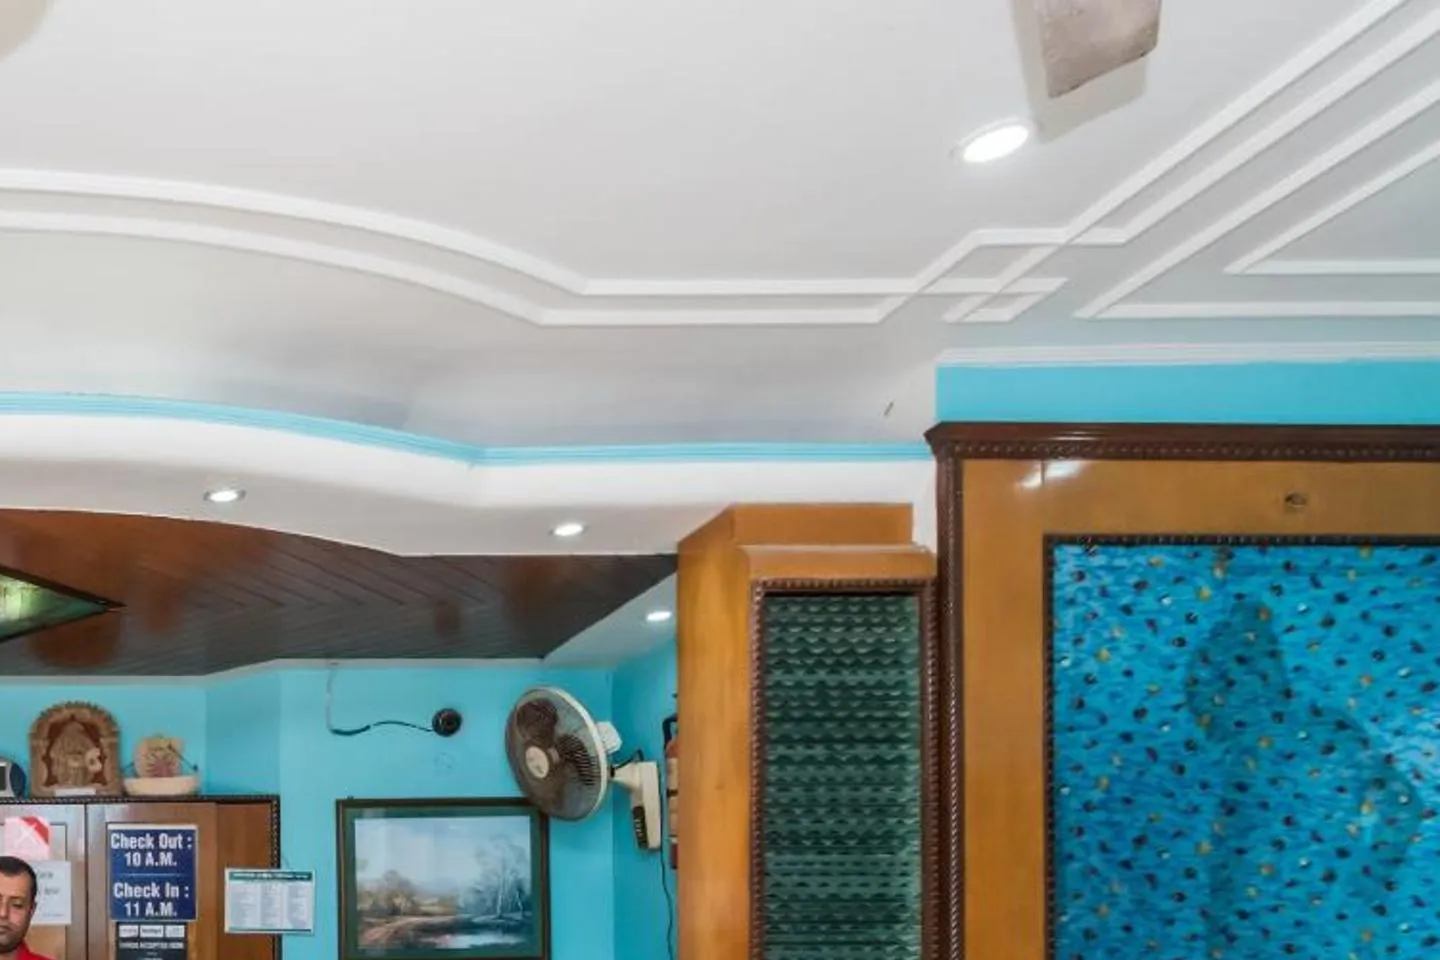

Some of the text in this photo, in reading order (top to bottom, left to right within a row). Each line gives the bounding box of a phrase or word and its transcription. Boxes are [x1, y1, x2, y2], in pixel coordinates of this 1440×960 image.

[110, 832, 155, 850] Check
[158, 832, 183, 850] Out
[124, 851, 177, 867] 10 A.M.
[113, 881, 160, 899] Check
[164, 882, 180, 899] In
[124, 901, 178, 917] 11 A.M.
